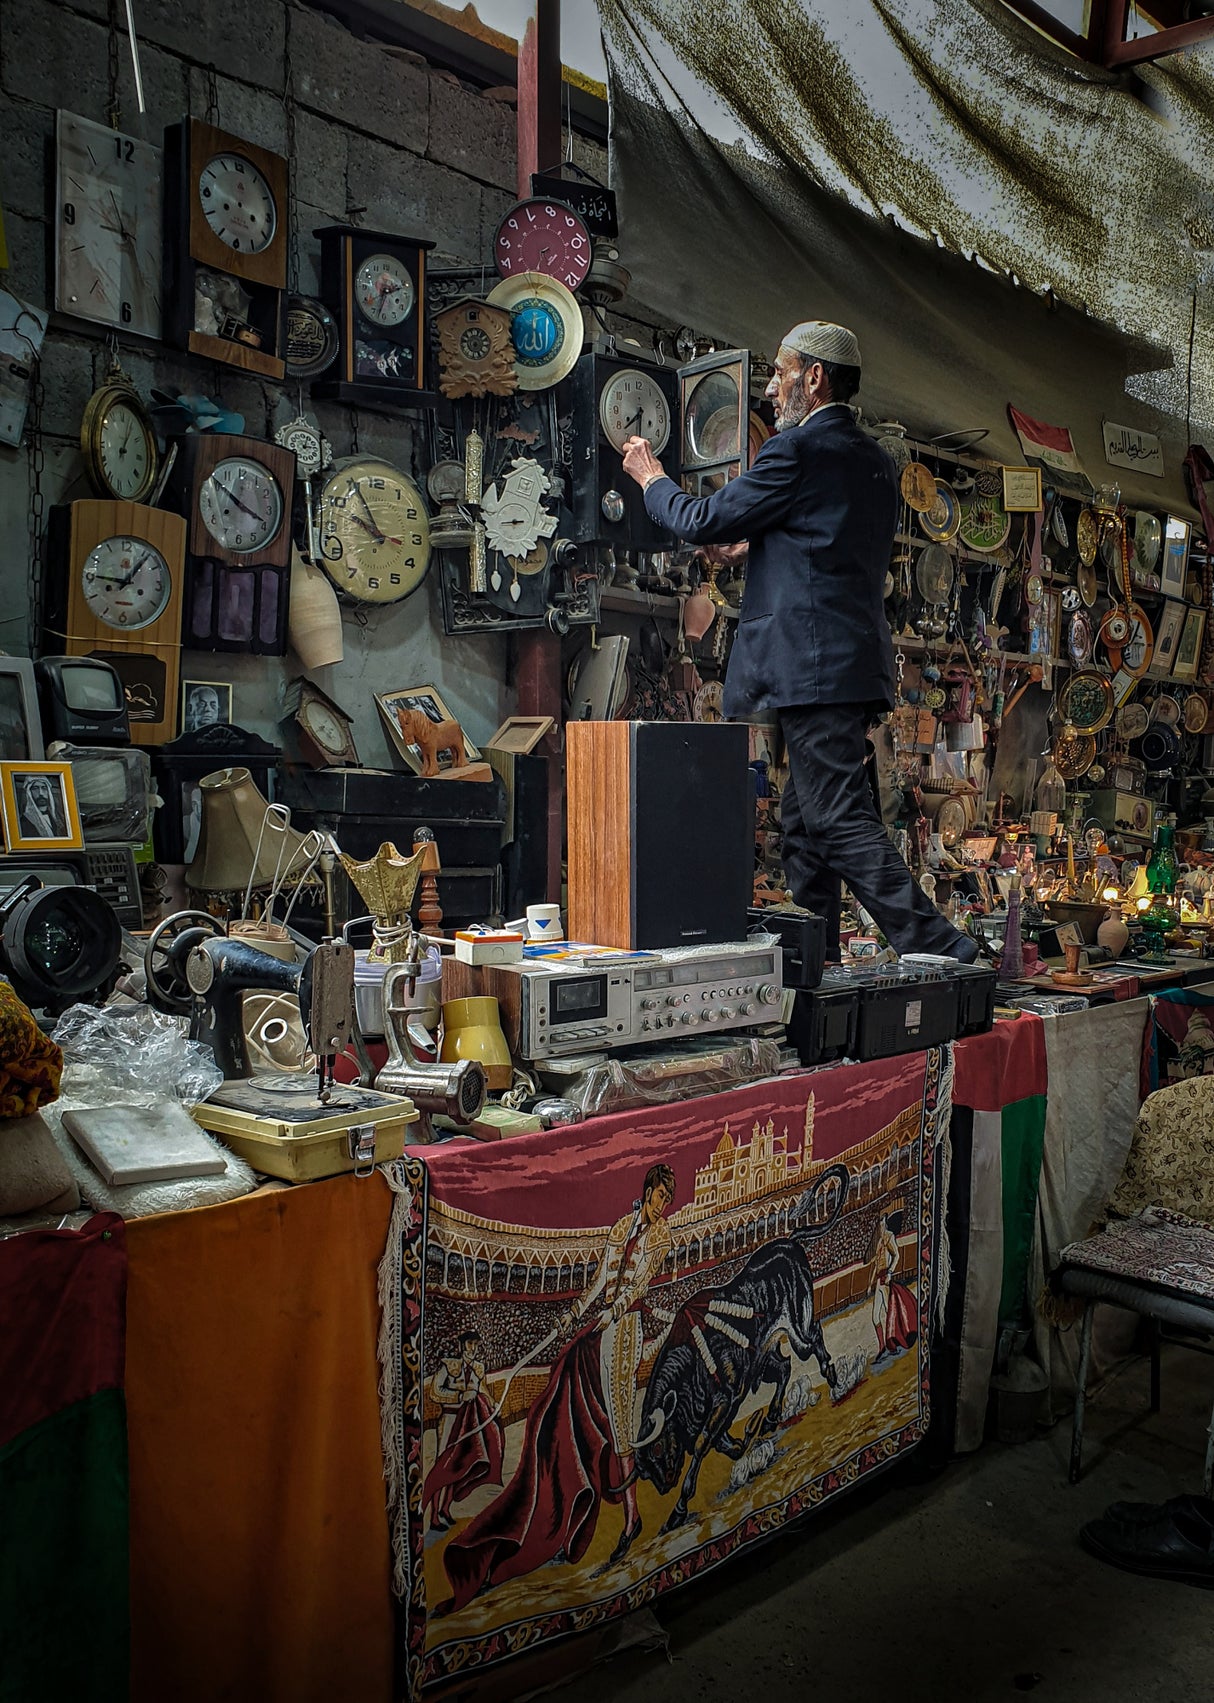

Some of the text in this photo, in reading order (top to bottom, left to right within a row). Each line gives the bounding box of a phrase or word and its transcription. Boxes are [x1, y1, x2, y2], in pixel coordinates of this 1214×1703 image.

[115, 137, 136, 163] 12
[64, 203, 75, 225] 9
[525, 208, 536, 222] 7
[545, 205, 557, 217] 8
[499, 237, 511, 249] 5
[570, 233, 587, 249] 10
[500, 257, 512, 270] 4
[574, 253, 588, 267] 11
[564, 271, 581, 287] 12
[121, 302, 132, 323] 6
[516, 311, 550, 351] الله
[624, 382, 631, 392] 11
[635, 381, 643, 390] 12
[616, 391, 623, 401] 10
[613, 405, 619, 415] 9
[655, 400, 662, 410] 2
[615, 421, 622, 430] 8
[658, 415, 664, 424] 3
[655, 429, 661, 438] 4
[223, 470, 232, 482] 11
[368, 477, 386, 491] 12
[263, 489, 270, 499] 2
[395, 489, 402, 501] 1
[265, 505, 273, 515] 3
[406, 508, 418, 521] 2
[261, 521, 268, 532] 4
[234, 534, 243, 545] 6
[250, 532, 257, 542] 5
[412, 534, 423, 546] 3
[121, 541, 134, 553] 12
[404, 557, 416, 570] 4
[85, 571, 96, 585] 9
[347, 566, 358, 579] 7
[368, 576, 380, 589] 6
[390, 573, 401, 586] 5
[154, 580, 163, 592] 3
[117, 611, 128, 623] 6
